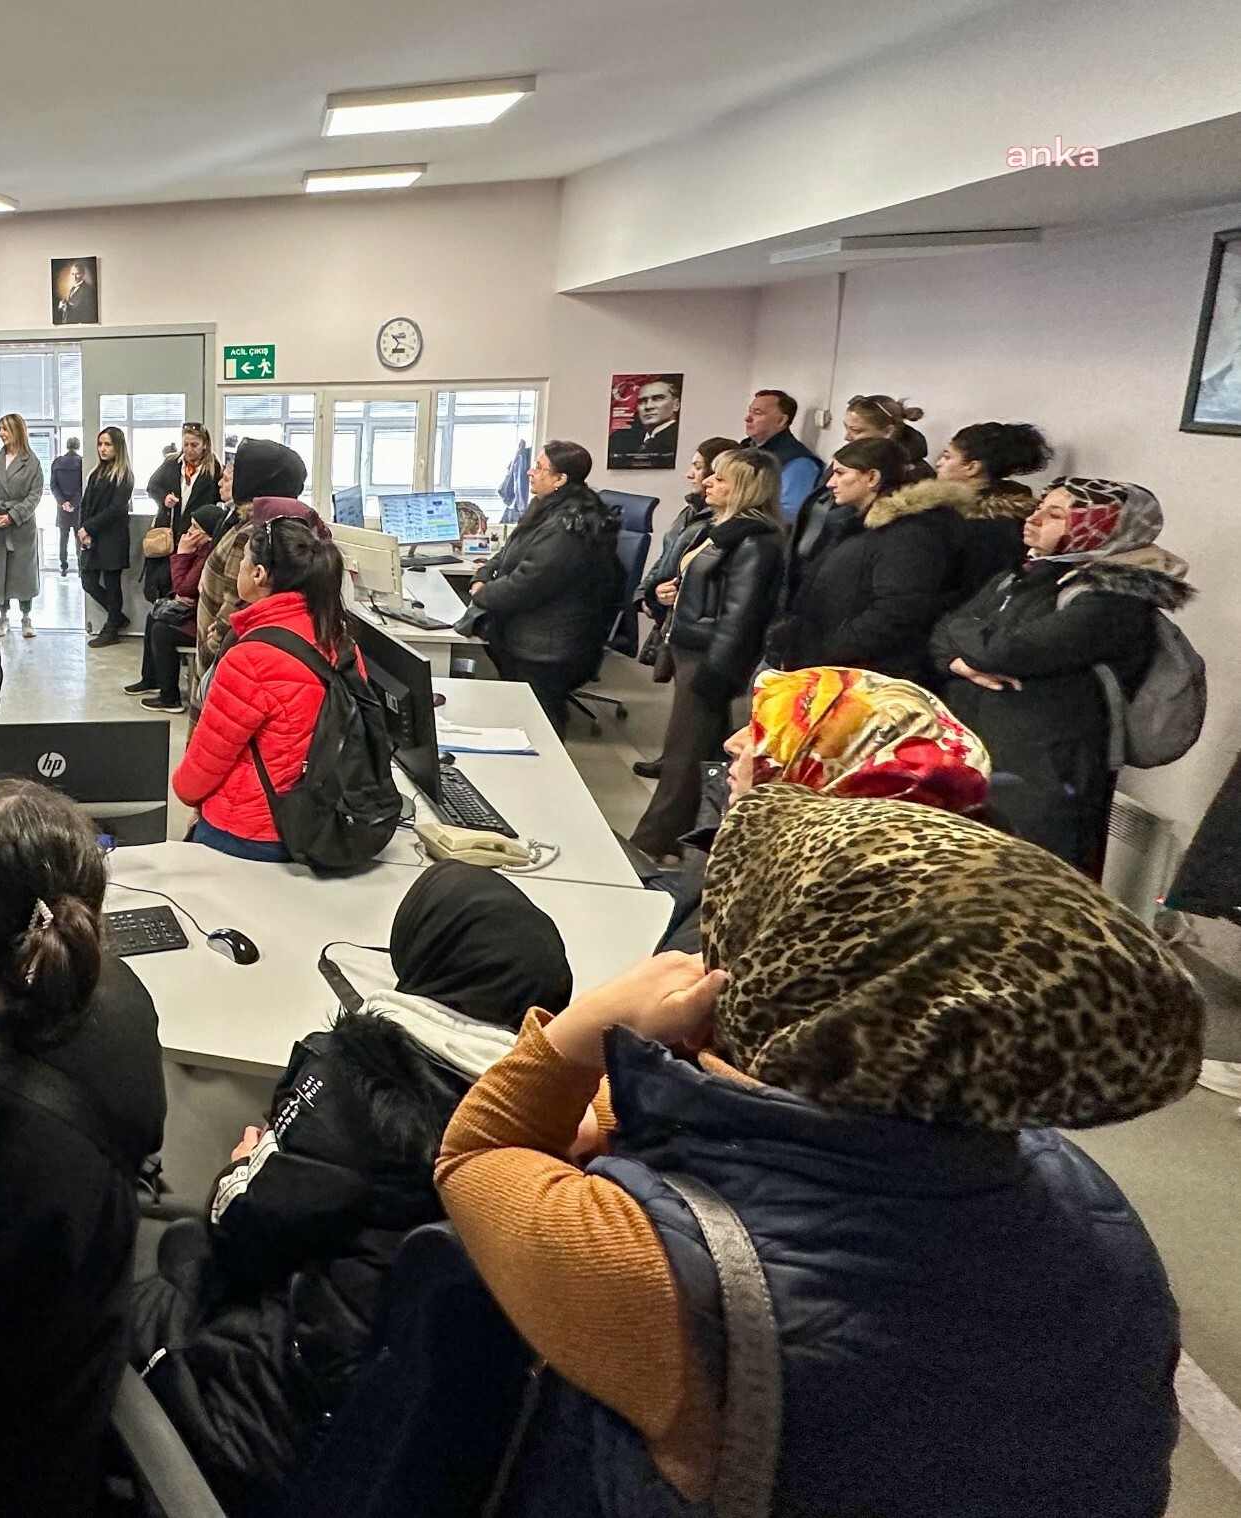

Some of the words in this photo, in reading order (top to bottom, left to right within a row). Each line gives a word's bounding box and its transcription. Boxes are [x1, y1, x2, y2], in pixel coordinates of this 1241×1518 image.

[230, 348, 247, 356] ACİL
[249, 347, 269, 356] ÇIKIŞ
[42, 752, 63, 778] hp
[302, 1075, 315, 1091] 1st
[305, 1080, 324, 1100] Rule
